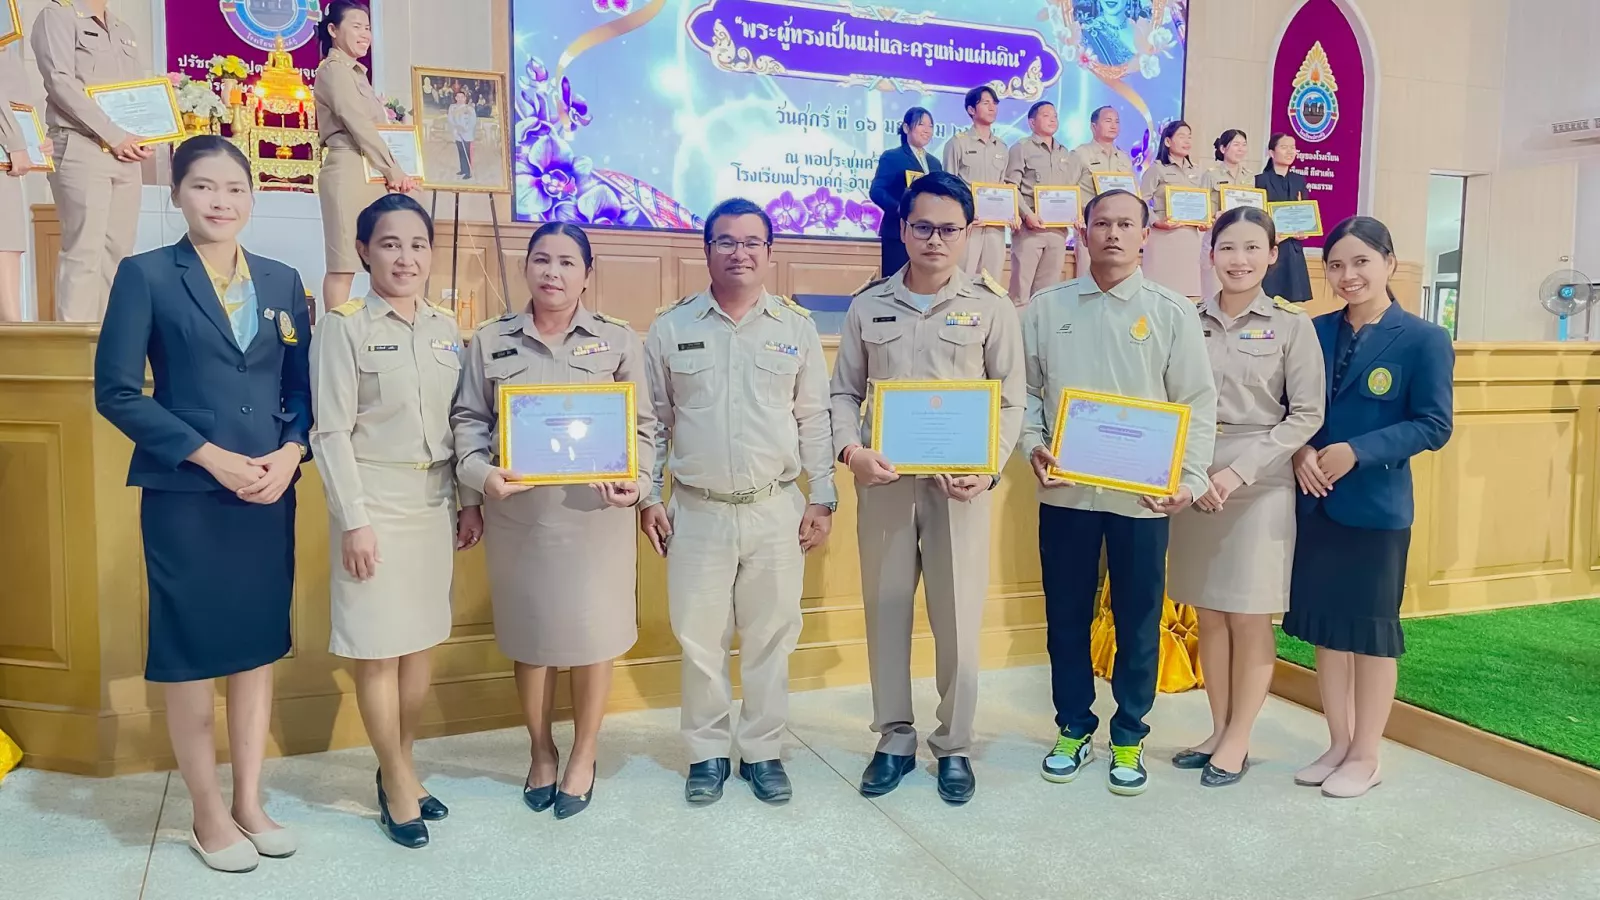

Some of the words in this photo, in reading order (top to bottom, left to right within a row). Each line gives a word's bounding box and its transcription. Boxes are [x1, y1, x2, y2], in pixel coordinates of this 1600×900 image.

[776, 101, 831, 133] วันศุกร์
[836, 105, 848, 129] ที่
[855, 117, 876, 131] ๑๖
[785, 152, 799, 164] ณ
[730, 161, 842, 193] โรงเรียนปรางค์กู่
